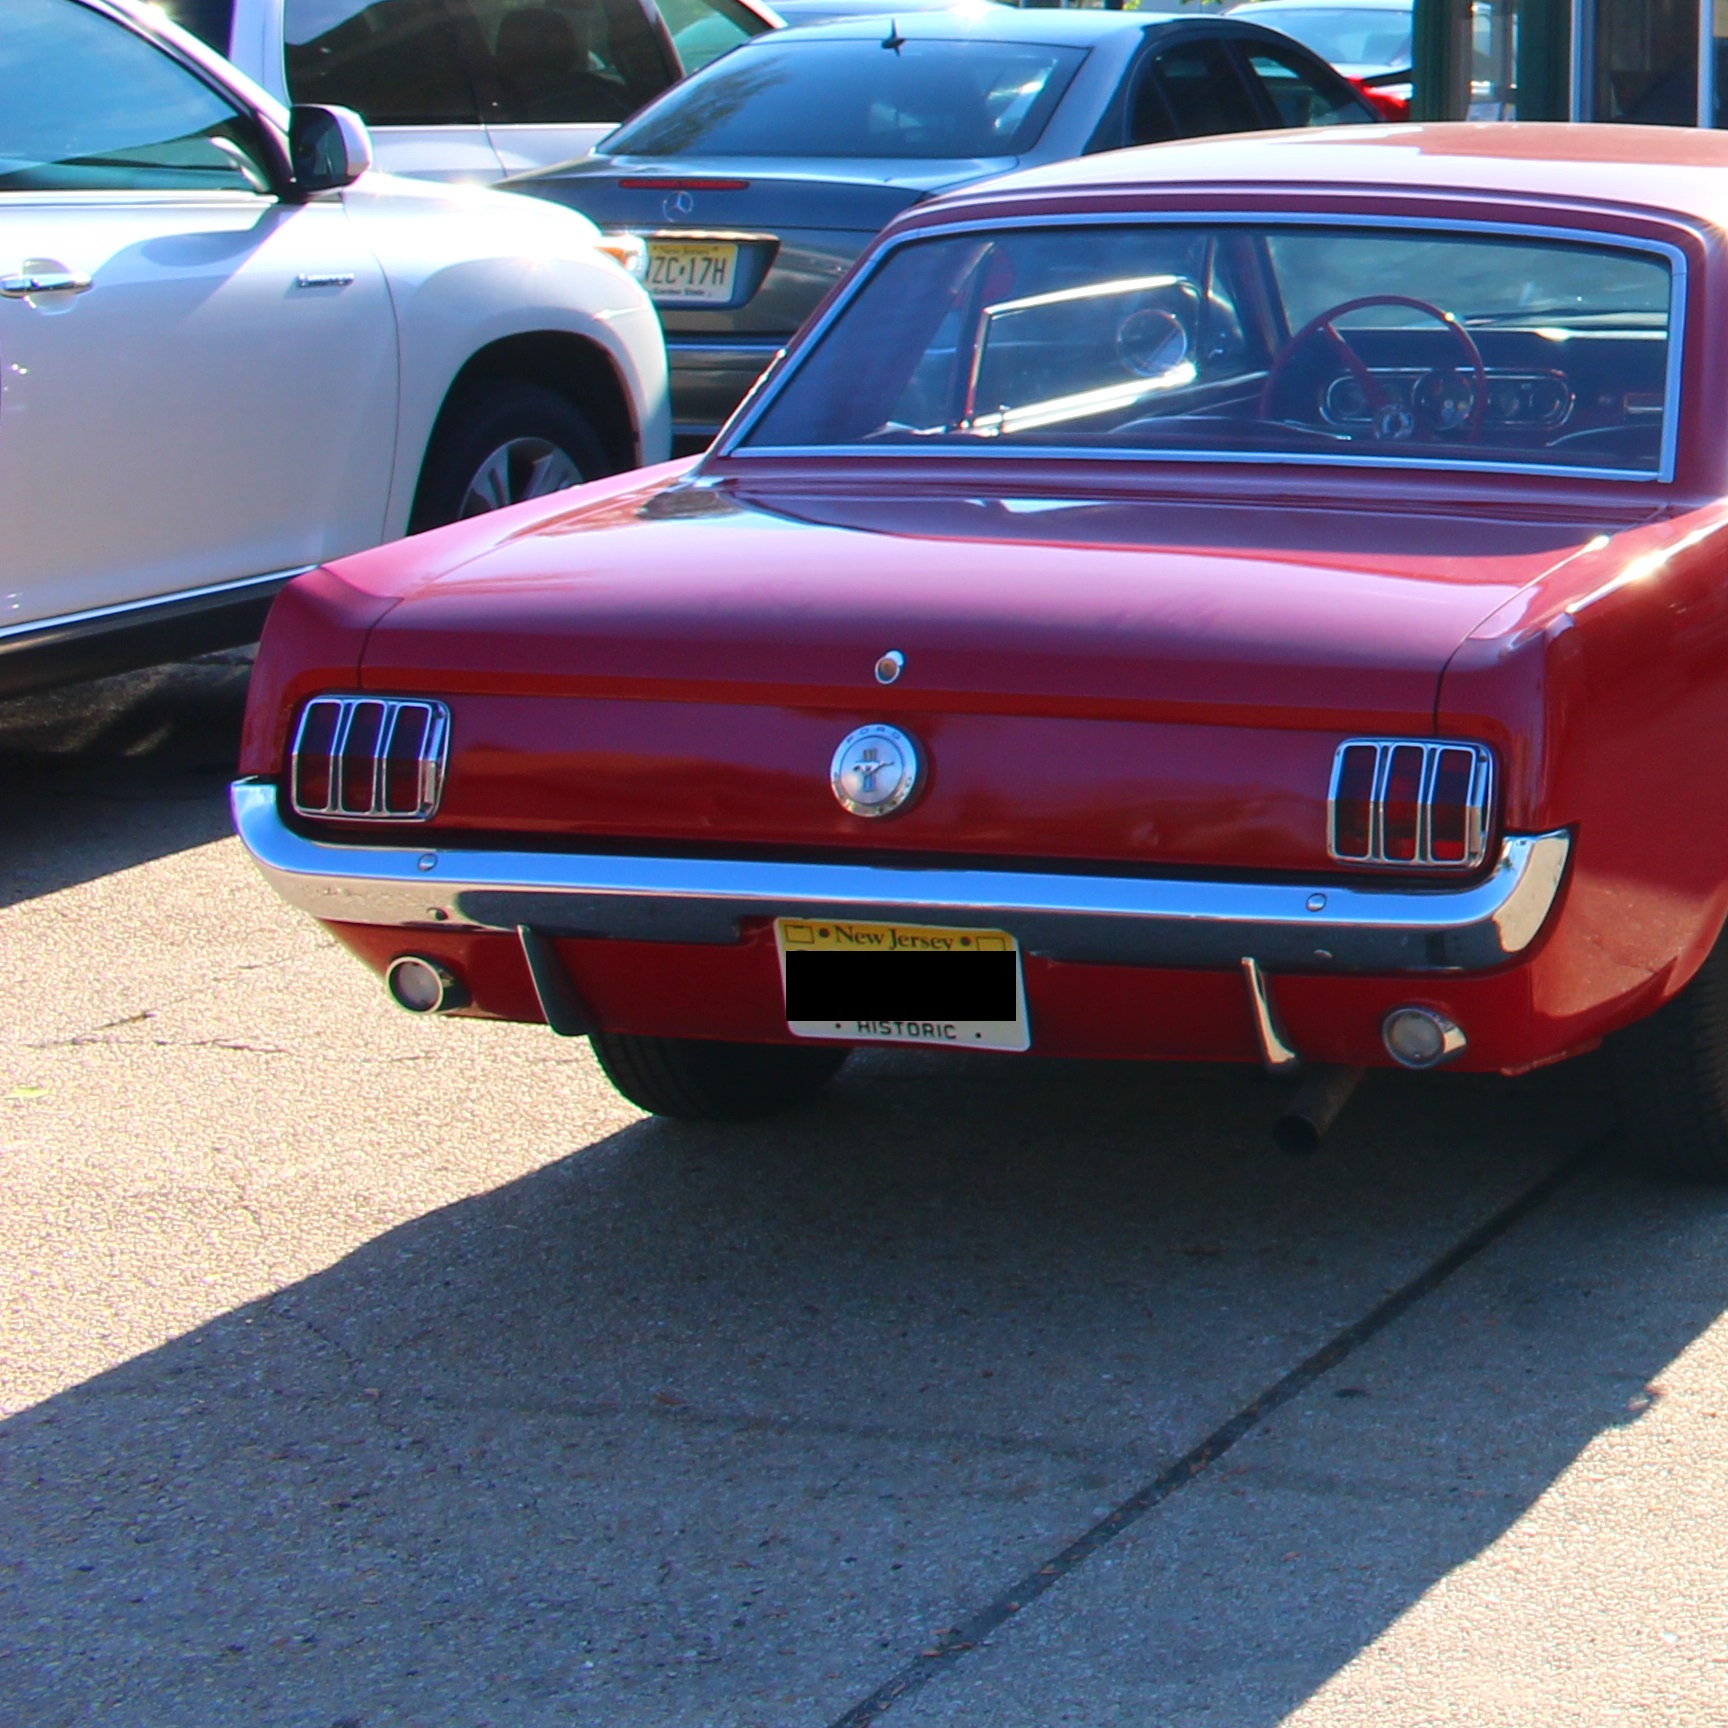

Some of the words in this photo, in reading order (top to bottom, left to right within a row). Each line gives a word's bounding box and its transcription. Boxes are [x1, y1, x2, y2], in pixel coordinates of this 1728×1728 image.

[846, 726, 901, 743] FORD
[834, 925, 885, 945] New
[889, 928, 954, 951] Jersey
[857, 1021, 957, 1040] HISTORIC
